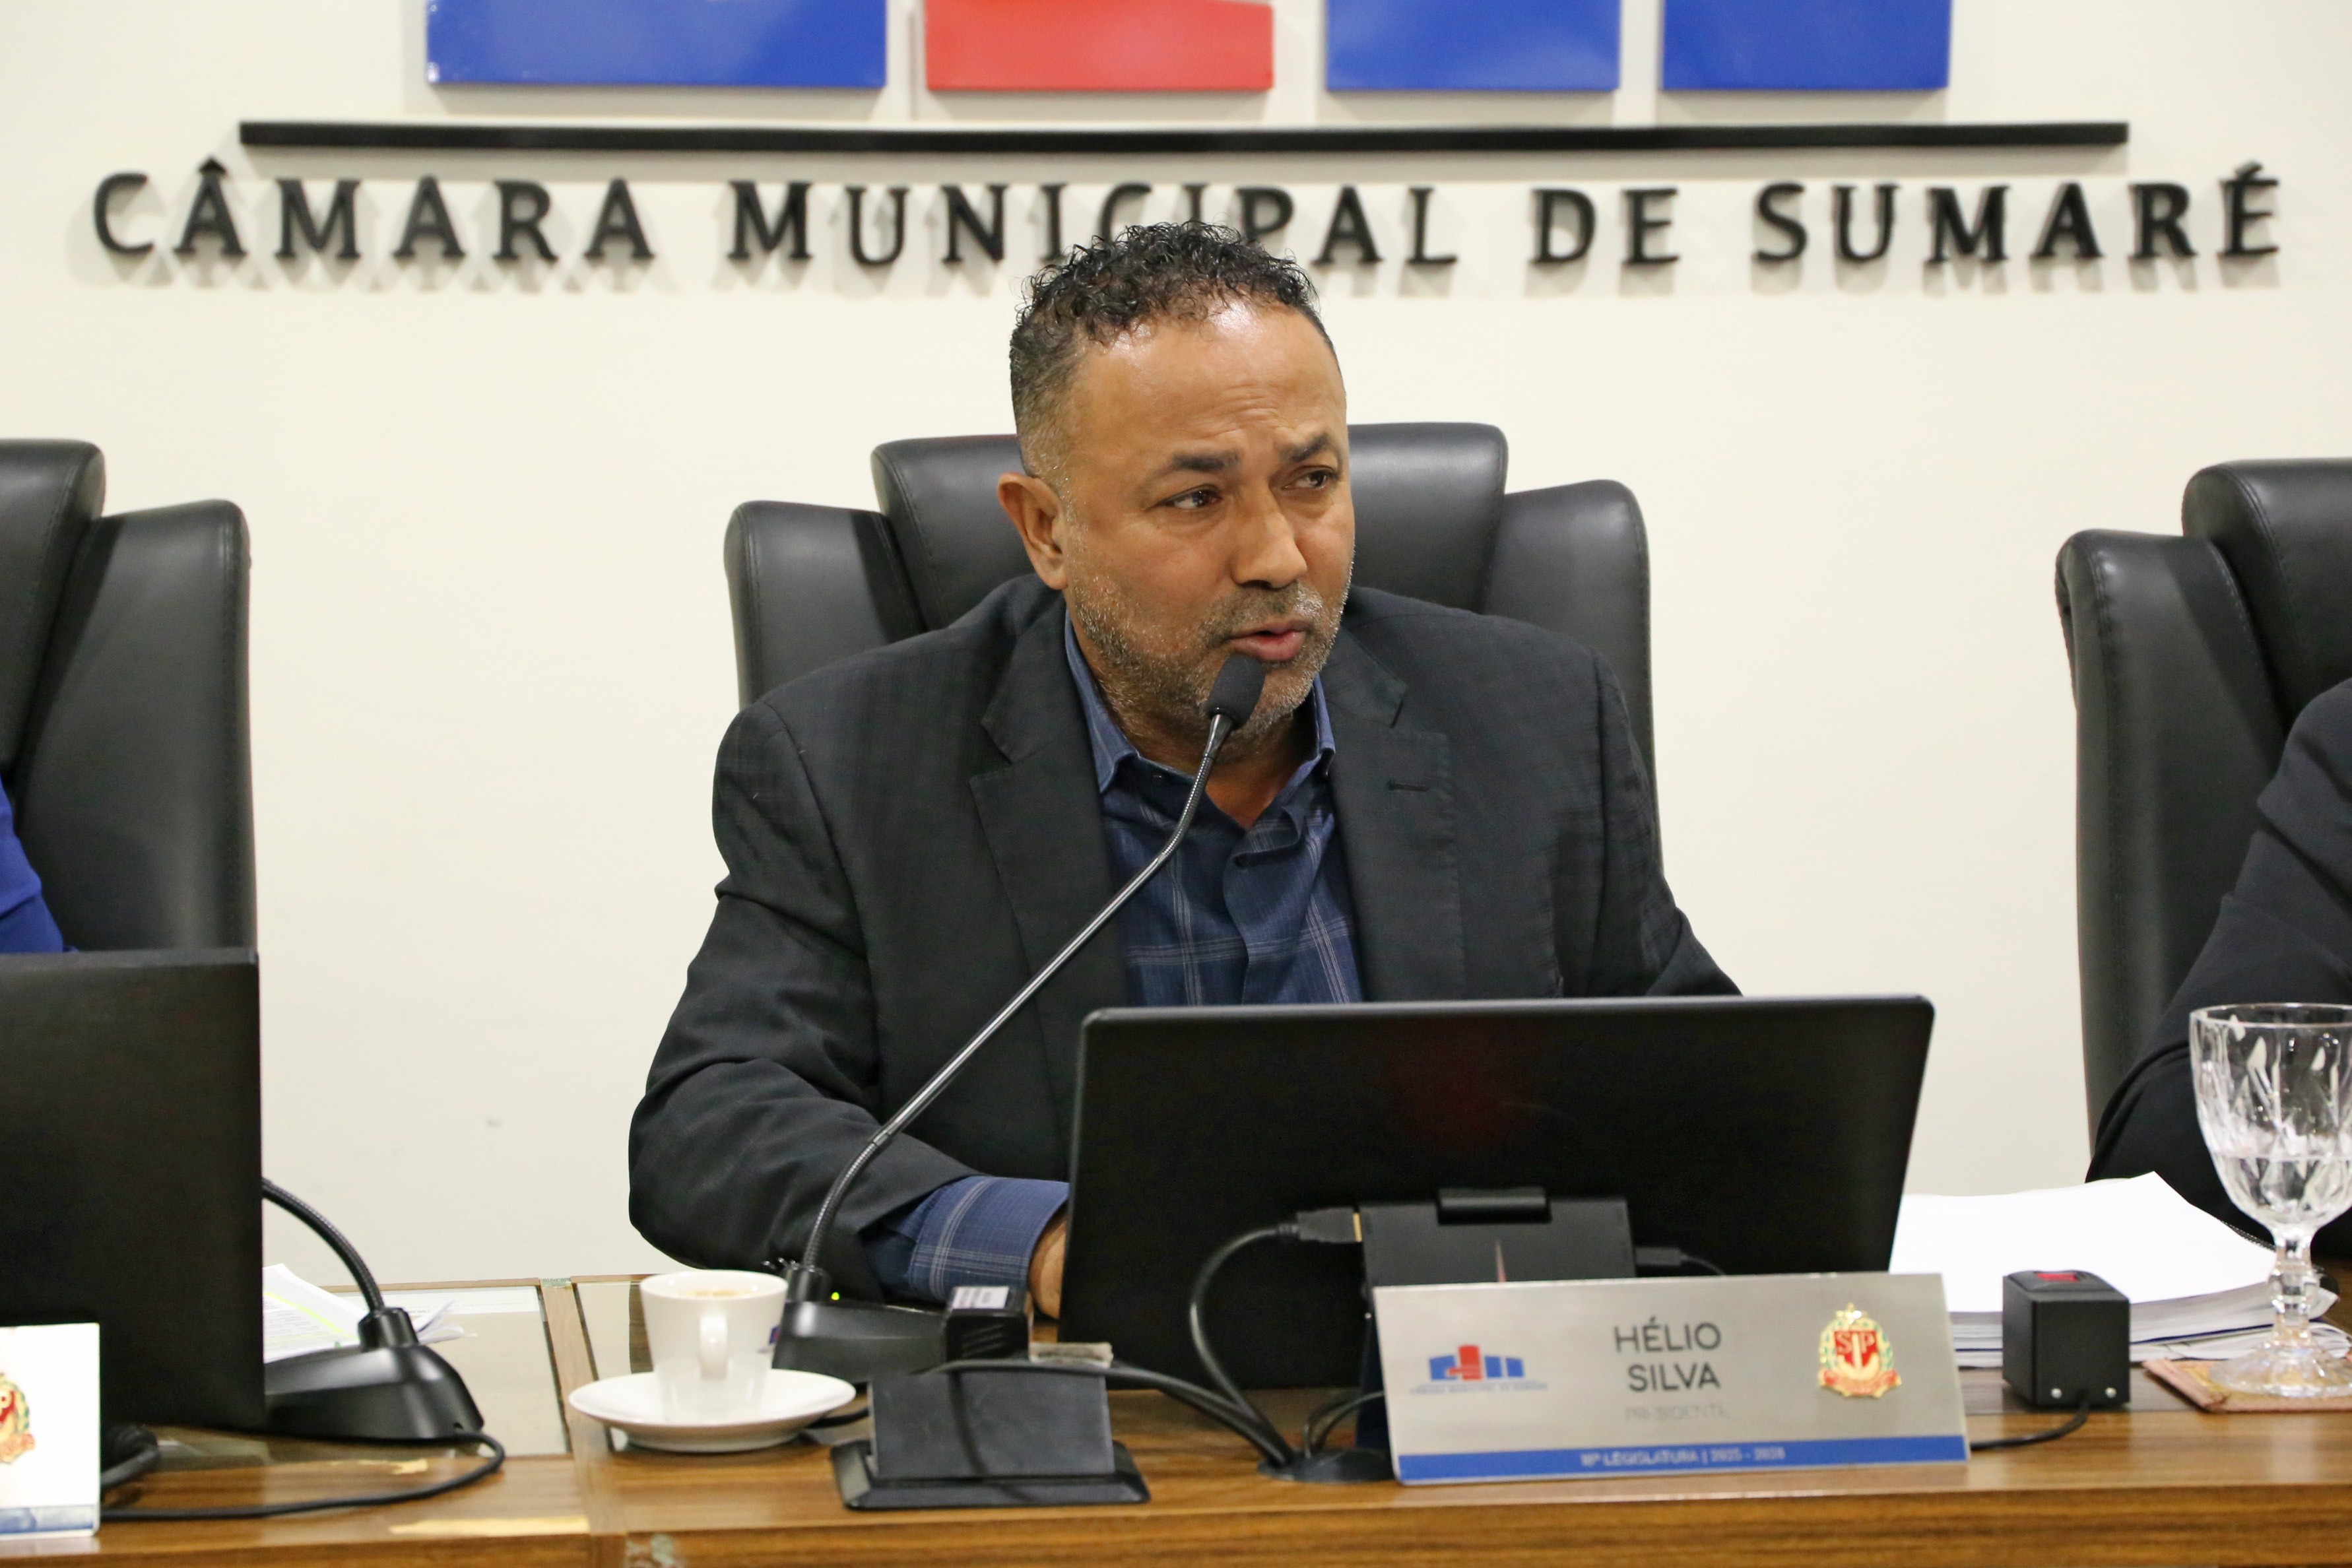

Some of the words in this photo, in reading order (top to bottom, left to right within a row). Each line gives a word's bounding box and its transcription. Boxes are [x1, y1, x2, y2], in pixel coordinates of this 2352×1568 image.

[93, 156, 656, 262] CÂMARA
[1530, 187, 1680, 265] DE
[1754, 162, 2279, 264] SUMARÉ
[1614, 1316, 1721, 1352] HÉLIO
[1627, 1362, 1721, 1392] SILVA
